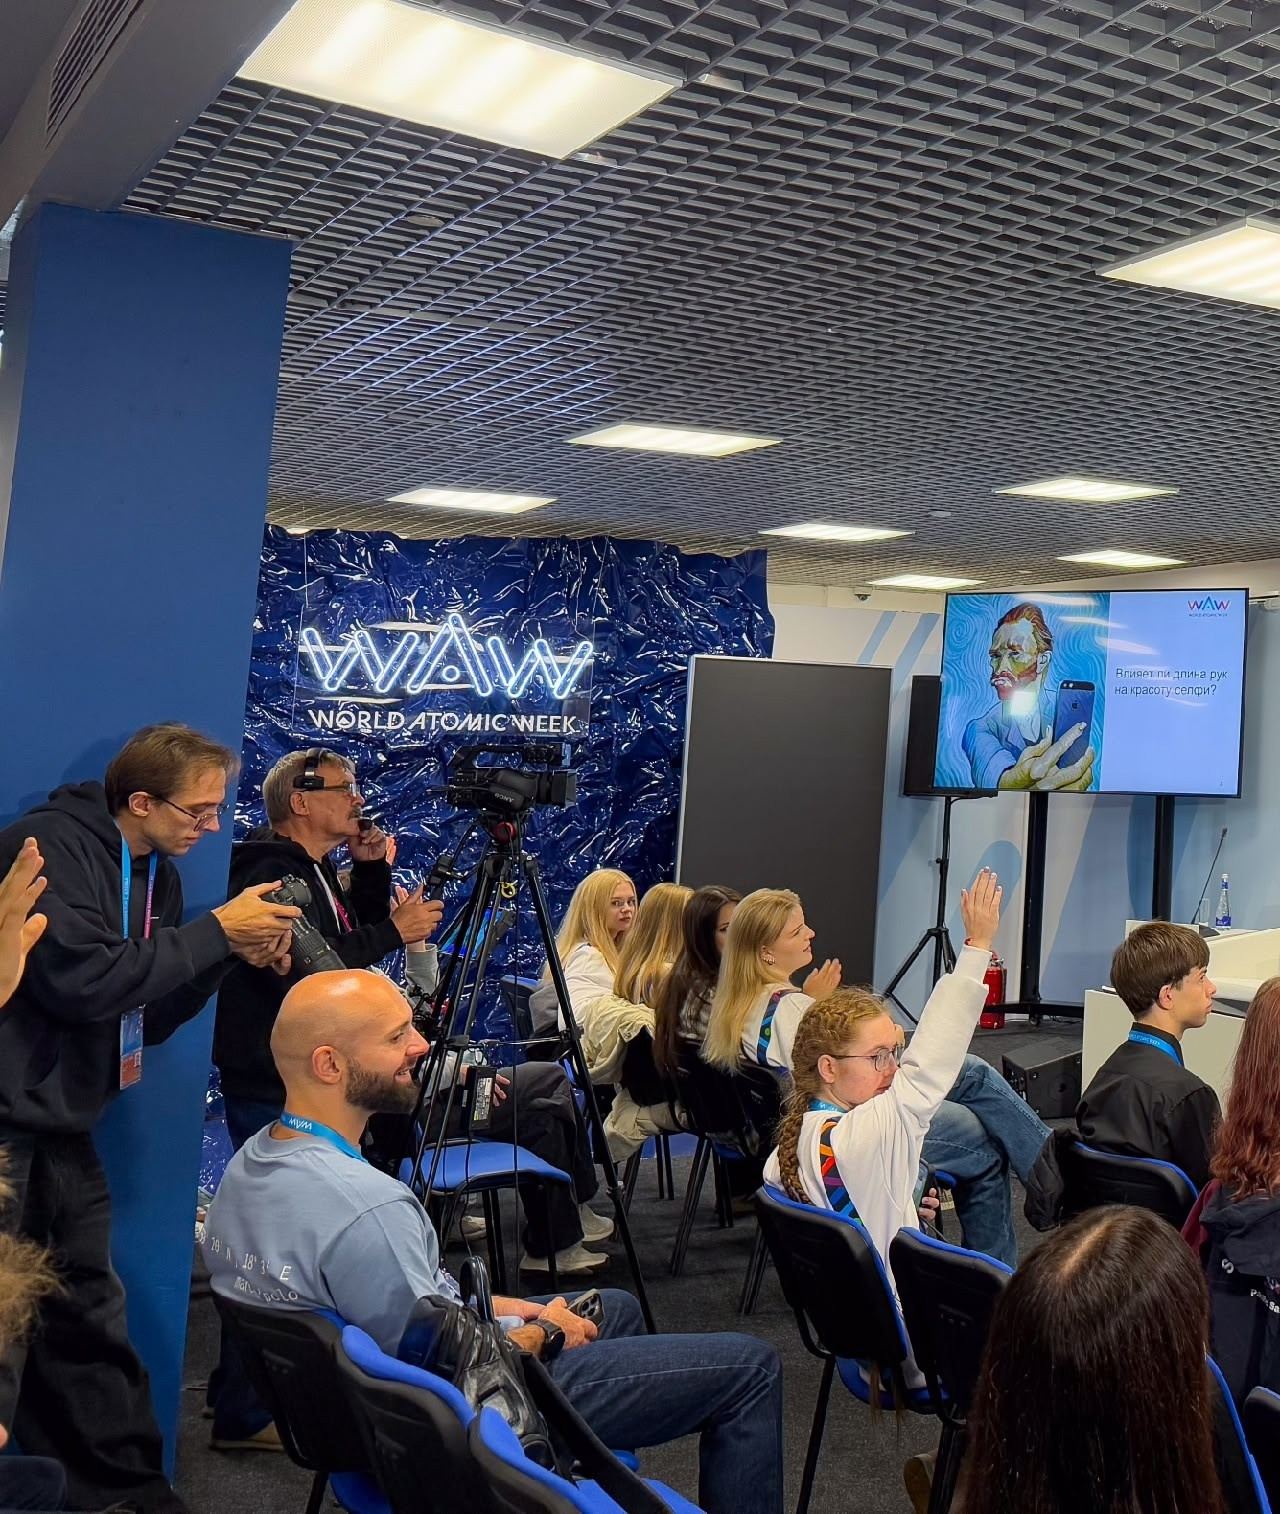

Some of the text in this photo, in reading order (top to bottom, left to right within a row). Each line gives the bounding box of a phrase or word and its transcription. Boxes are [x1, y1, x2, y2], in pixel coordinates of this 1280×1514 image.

[1187, 596, 1230, 611] WAW
[302, 612, 594, 699] WAW
[1115, 668, 1153, 679] Влияет
[1173, 670, 1206, 680] длина
[1210, 670, 1227, 681] рук
[1115, 684, 1217, 697] на красоту селфи?
[308, 709, 579, 733] WORLD ATOMIC WEEK
[280, 1265, 292, 1281] E
